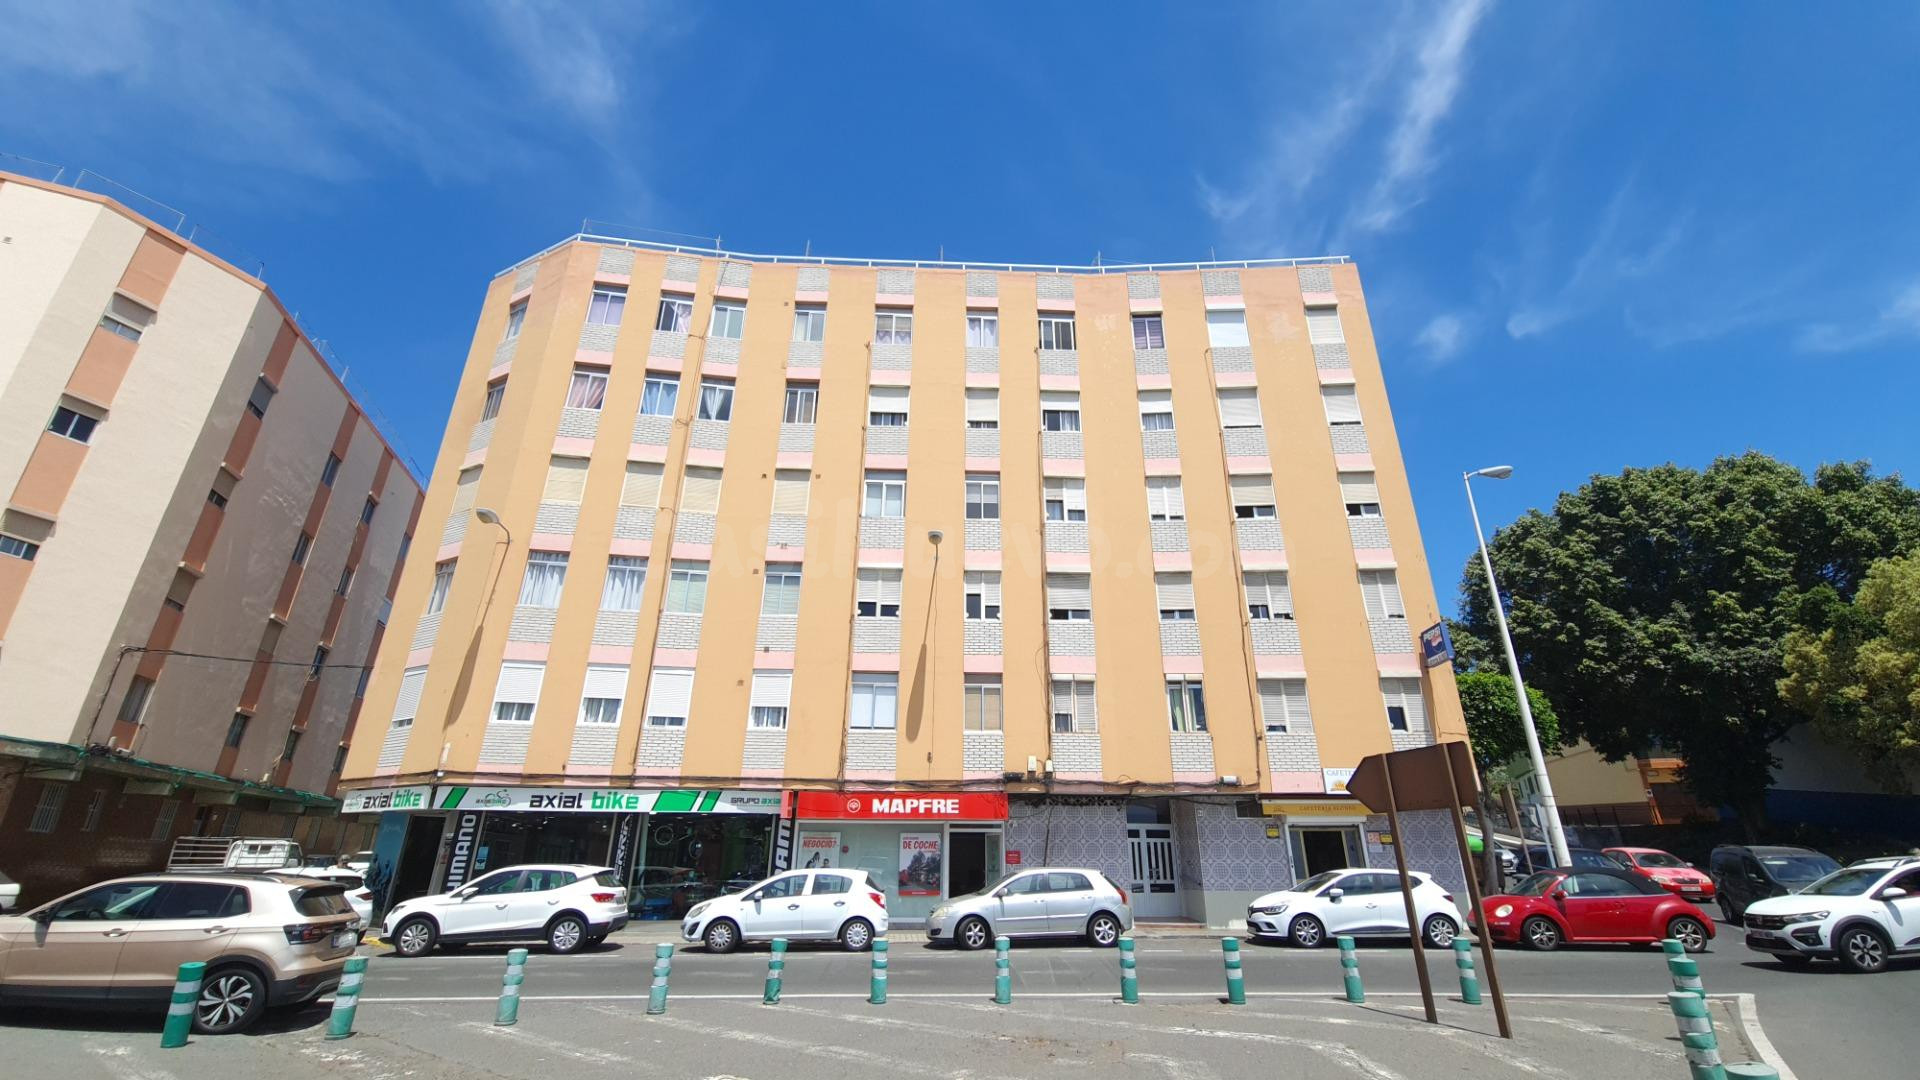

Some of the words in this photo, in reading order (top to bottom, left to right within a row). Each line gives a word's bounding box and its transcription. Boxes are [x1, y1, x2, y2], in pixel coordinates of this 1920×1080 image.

[362, 791, 393, 809] axial
[392, 789, 423, 808] bike
[529, 792, 583, 809] axial
[590, 790, 640, 810] bike
[730, 797, 760, 805] GRUPO
[872, 798, 960, 814] MAPFRE
[446, 814, 477, 892] HIMANO
[902, 840, 913, 850] DE
[913, 840, 938, 850] COCHE
